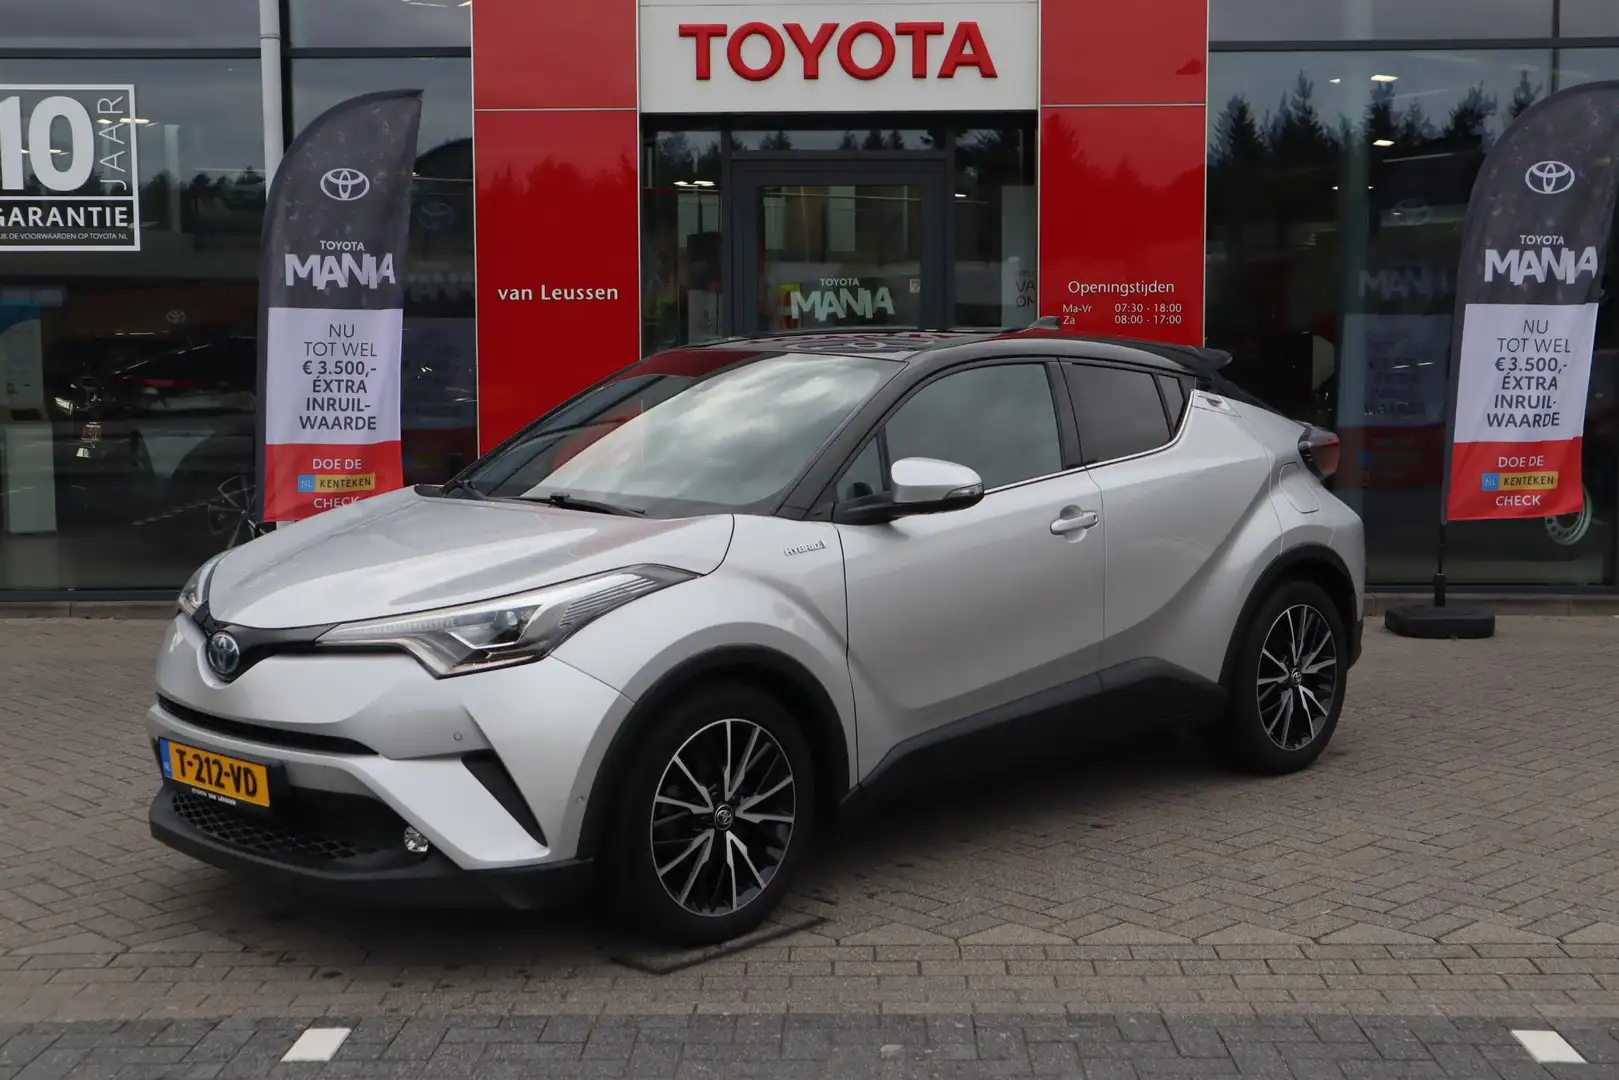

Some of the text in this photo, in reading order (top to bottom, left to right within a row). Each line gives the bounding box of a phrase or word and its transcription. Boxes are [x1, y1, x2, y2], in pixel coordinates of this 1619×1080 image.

[678, 21, 998, 82] TOYOTA
[0, 96, 95, 192] 10
[97, 95, 127, 191] JAAR
[9, 232, 19, 241] DE
[20, 232, 77, 241] VOORWAARDEN
[78, 232, 89, 241] OP
[1519, 234, 1565, 245] TOYOTA
[320, 240, 365, 252] TOYOTA
[284, 252, 396, 291] MANIA
[1483, 246, 1599, 286] MANIA
[819, 277, 860, 287] TOYOTA
[1067, 280, 1176, 297] Openingstijden
[497, 284, 619, 301] van Leussen
[790, 286, 896, 322] MANIA
[1062, 304, 1093, 314] Ma-Vr
[1114, 303, 1144, 313] 07:30
[1154, 303, 1182, 313] 18:00
[1062, 315, 1076, 325] Za
[1114, 314, 1144, 325] 08:00
[1154, 314, 1182, 325] 17:00
[1523, 320, 1549, 334] NU
[329, 323, 355, 338] NU
[303, 341, 378, 357] TOT WEL
[1497, 338, 1571, 353] TOT WEL
[312, 375, 368, 394] ÉXTRA
[1501, 372, 1558, 391] ÉXTRA
[305, 397, 371, 412] INRUIL-
[1494, 394, 1557, 409] INRUIL-
[299, 415, 377, 430] WAARDE
[1487, 412, 1560, 428] WAARDE
[312, 458, 362, 470] DOE DE
[1498, 455, 1544, 468] DOE DE
[300, 477, 371, 489] NL KENTEKEN
[1503, 475, 1555, 487] KENTEKEN
[1495, 495, 1542, 507] CHECK
[175, 748, 258, 797] T-212-VD
